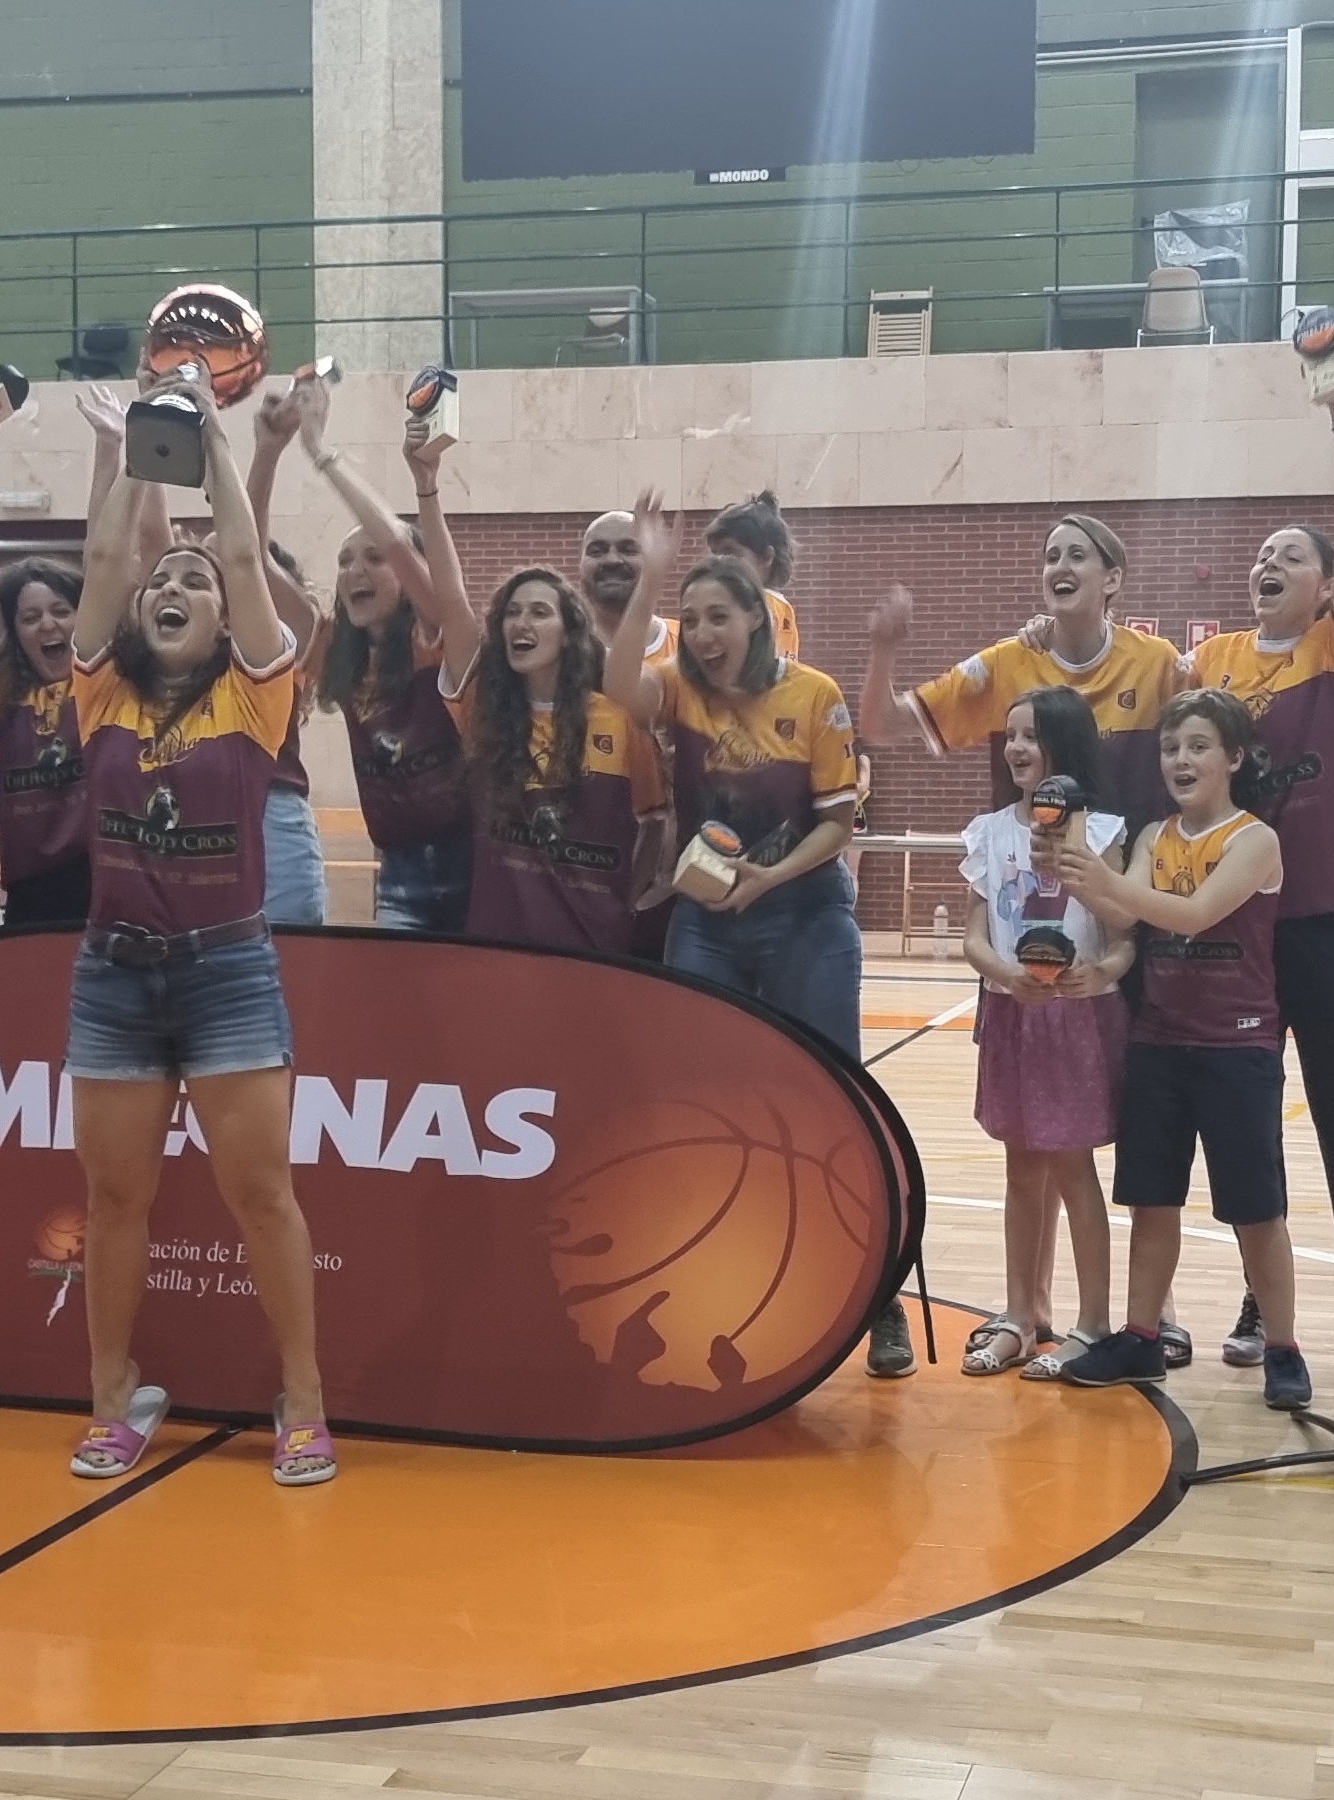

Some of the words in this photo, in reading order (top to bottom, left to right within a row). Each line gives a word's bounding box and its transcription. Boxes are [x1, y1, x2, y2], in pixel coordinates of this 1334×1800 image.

[719, 168, 770, 183] MONDO
[148, 1238, 201, 1262] ación
[206, 1241, 230, 1264] de
[146, 1269, 192, 1291] stilla
[197, 1277, 211, 1298] y
[216, 1273, 259, 1297] Leó
